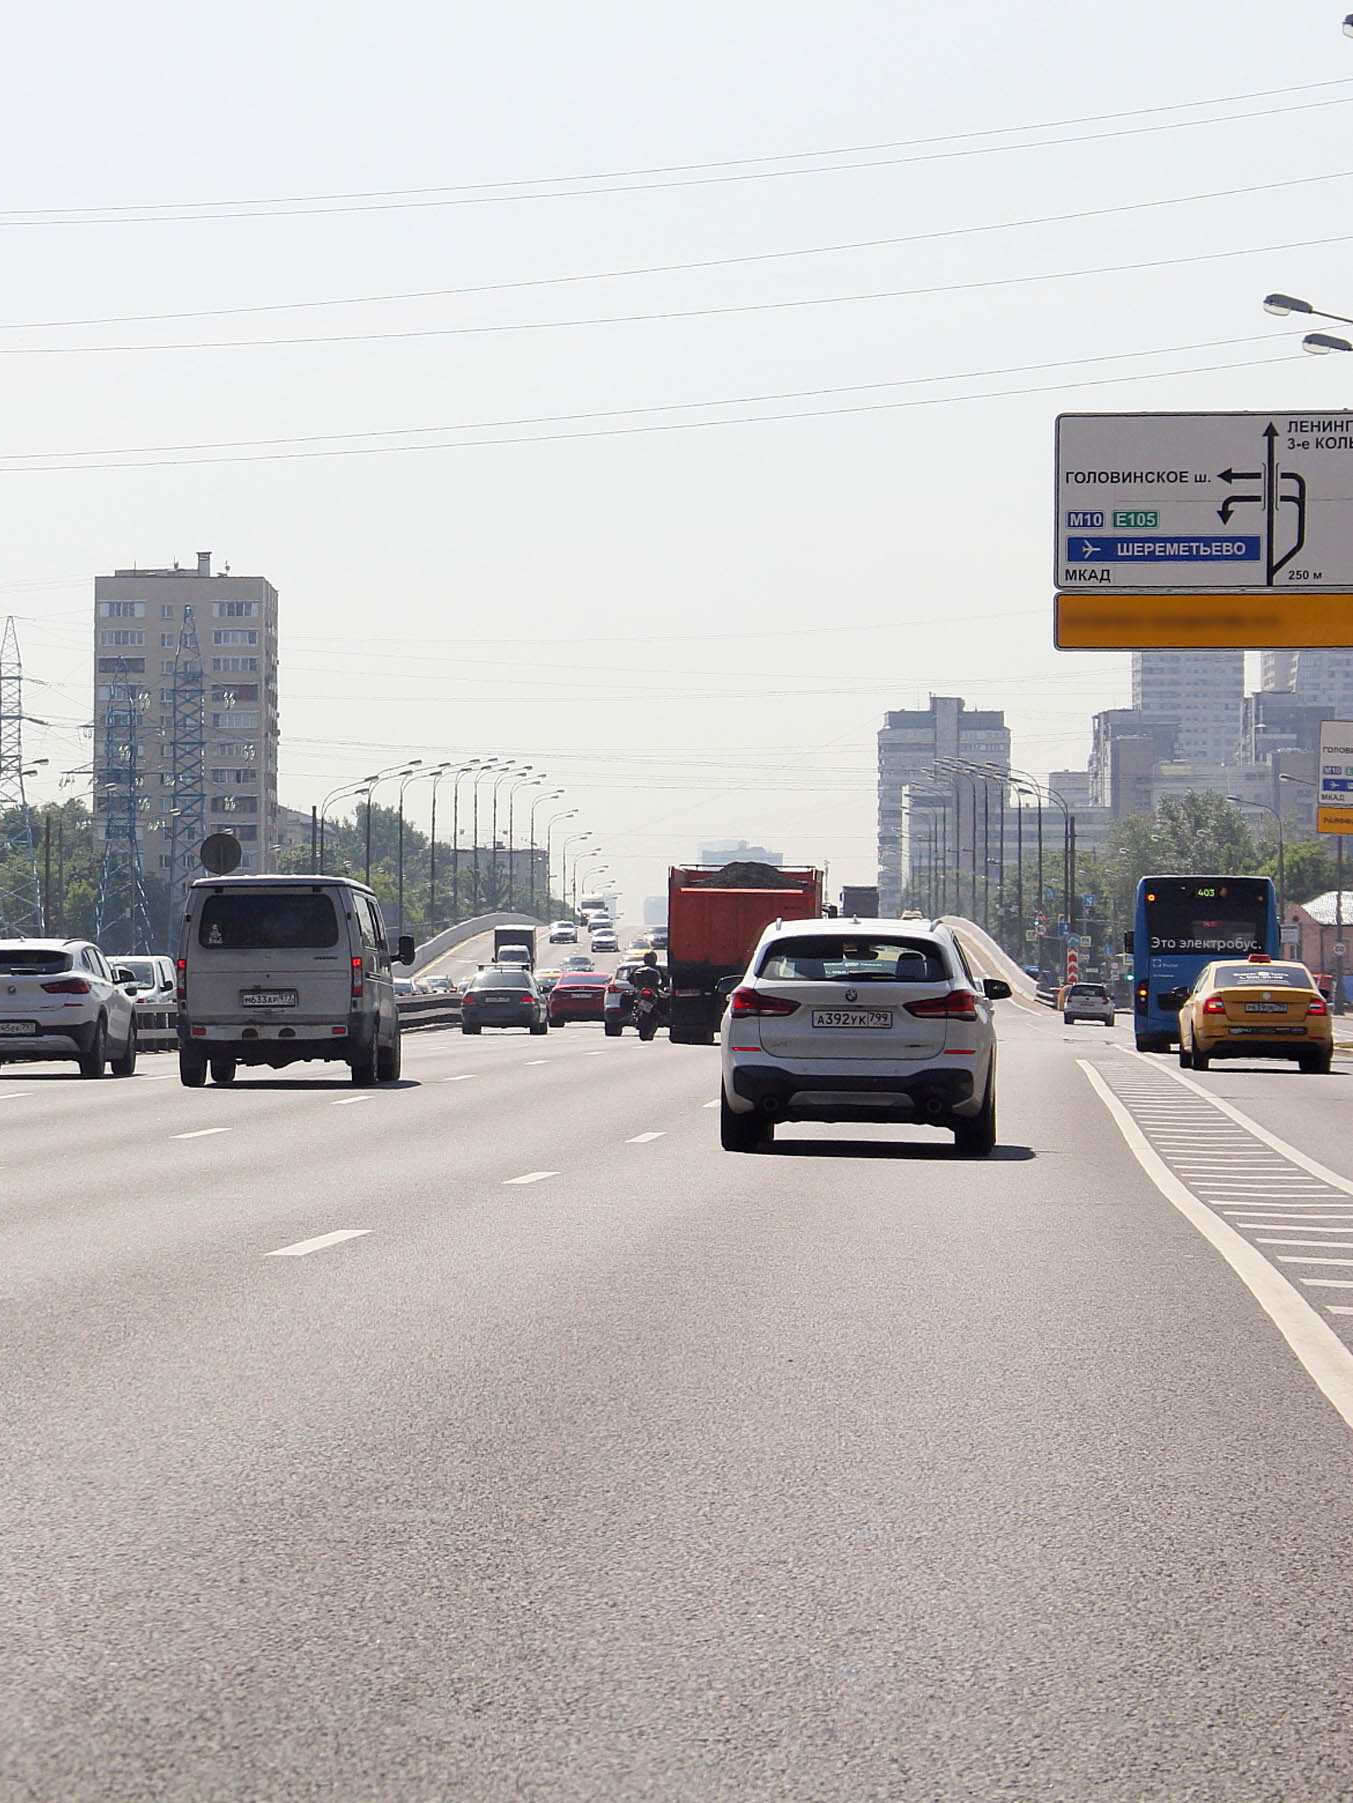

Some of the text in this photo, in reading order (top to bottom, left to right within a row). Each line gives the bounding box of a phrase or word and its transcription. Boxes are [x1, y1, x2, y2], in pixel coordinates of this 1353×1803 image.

[1287, 420, 1353, 433] ЛЕНИНГ
[1287, 437, 1310, 450] 3-е
[1065, 470, 1211, 484] ГОЛОВИНСКОЕ ш.
[1069, 513, 1103, 526] М10
[1115, 513, 1156, 526] E105
[1117, 542, 1246, 557] ШЕРЕМЕТЬЕВО
[1064, 568, 1111, 583] МКАД
[1288, 570, 1323, 580] 250 м
[1321, 793, 1345, 801] МКАД
[1198, 888, 1215, 897] 403
[1151, 937, 1262, 951] Это электробус.
[817, 1012, 888, 1025] А392УК 799
